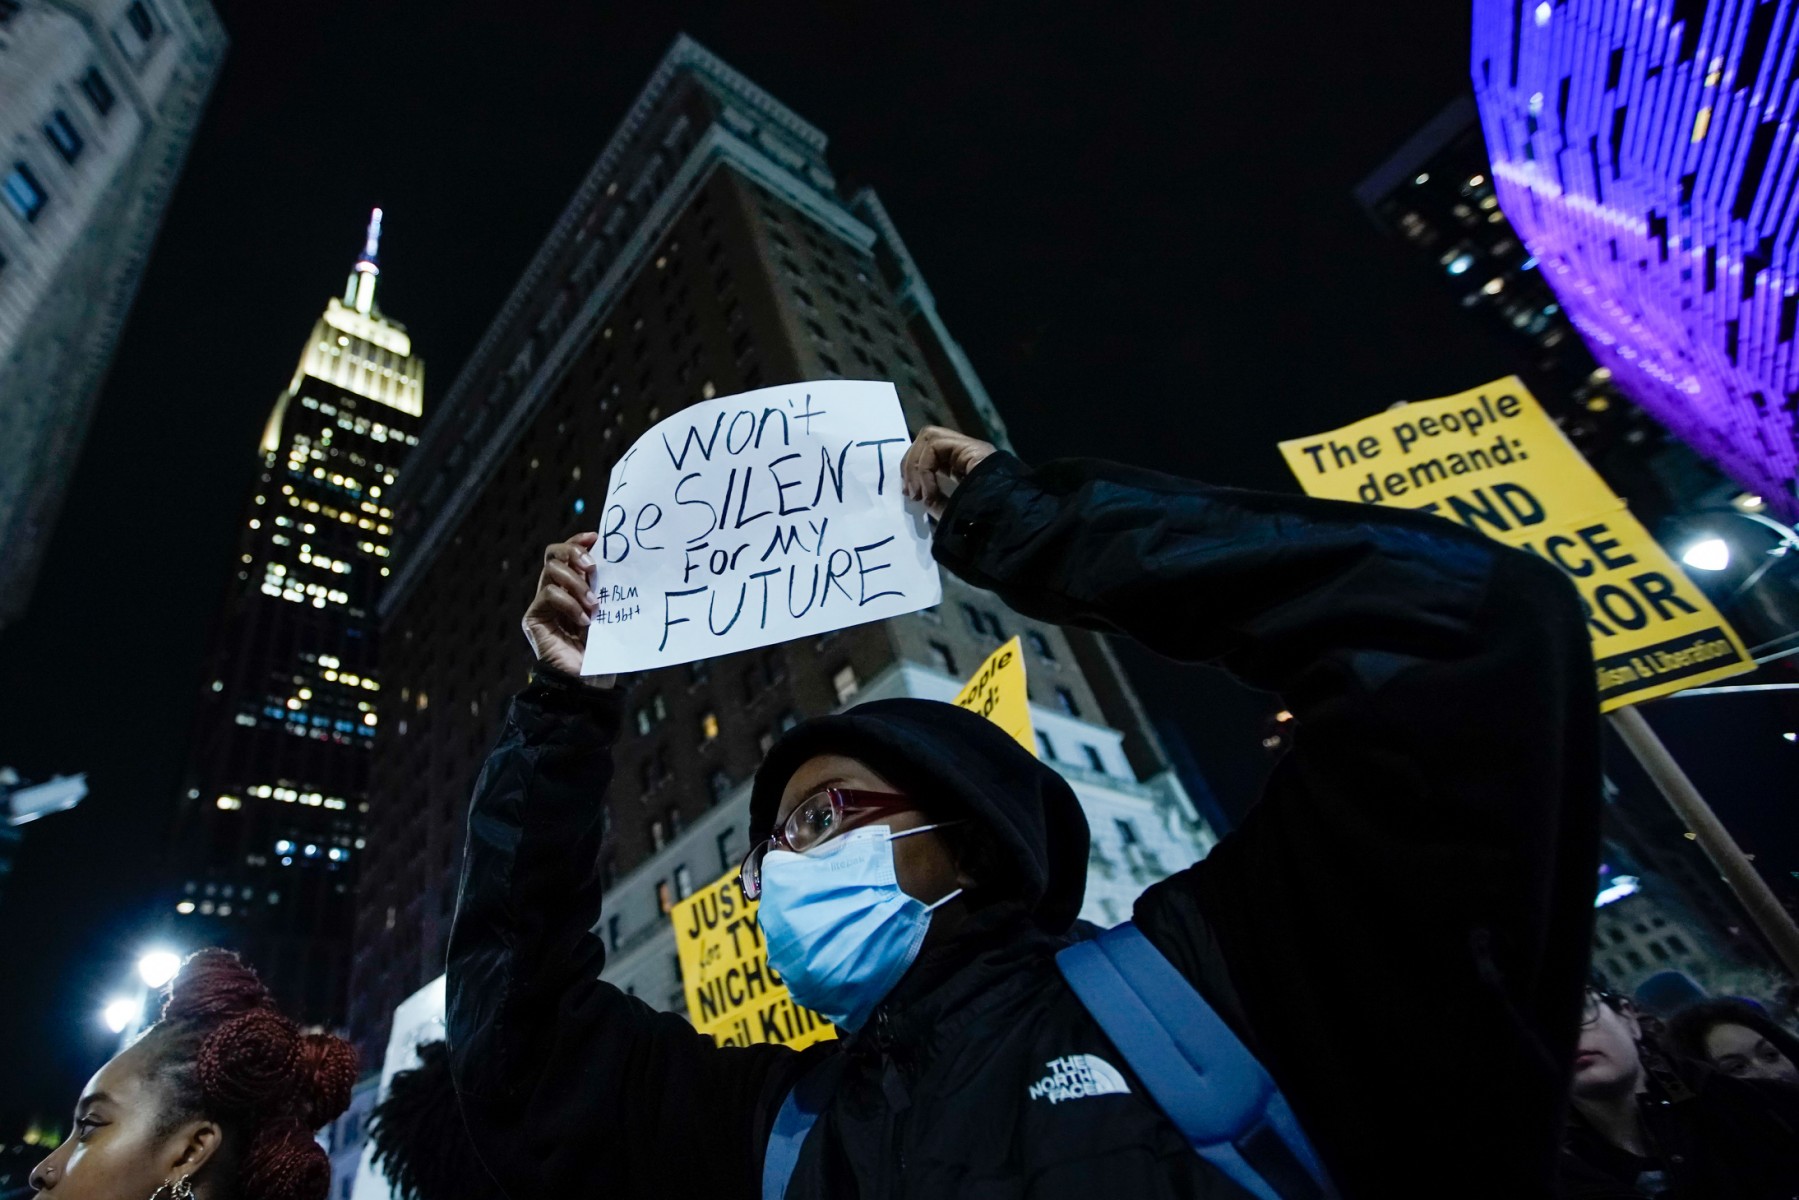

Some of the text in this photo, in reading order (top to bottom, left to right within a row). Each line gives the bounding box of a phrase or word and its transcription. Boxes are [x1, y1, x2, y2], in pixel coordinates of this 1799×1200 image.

[1302, 394, 1522, 475] The people
[612, 448, 638, 495] I
[1358, 435, 1529, 505] demand:
[602, 437, 906, 564] Be SILENT
[1416, 483, 1546, 532] ND
[1520, 522, 1639, 578] CE
[597, 584, 639, 604] #BLM
[658, 535, 907, 652] FUTURE
[1630, 657, 1656, 678] &
[1643, 639, 1734, 674] Liberation
[1028, 1068, 1093, 1100] NORTH
[1045, 1055, 1087, 1075] THE
[1048, 1083, 1099, 1104] FACE
